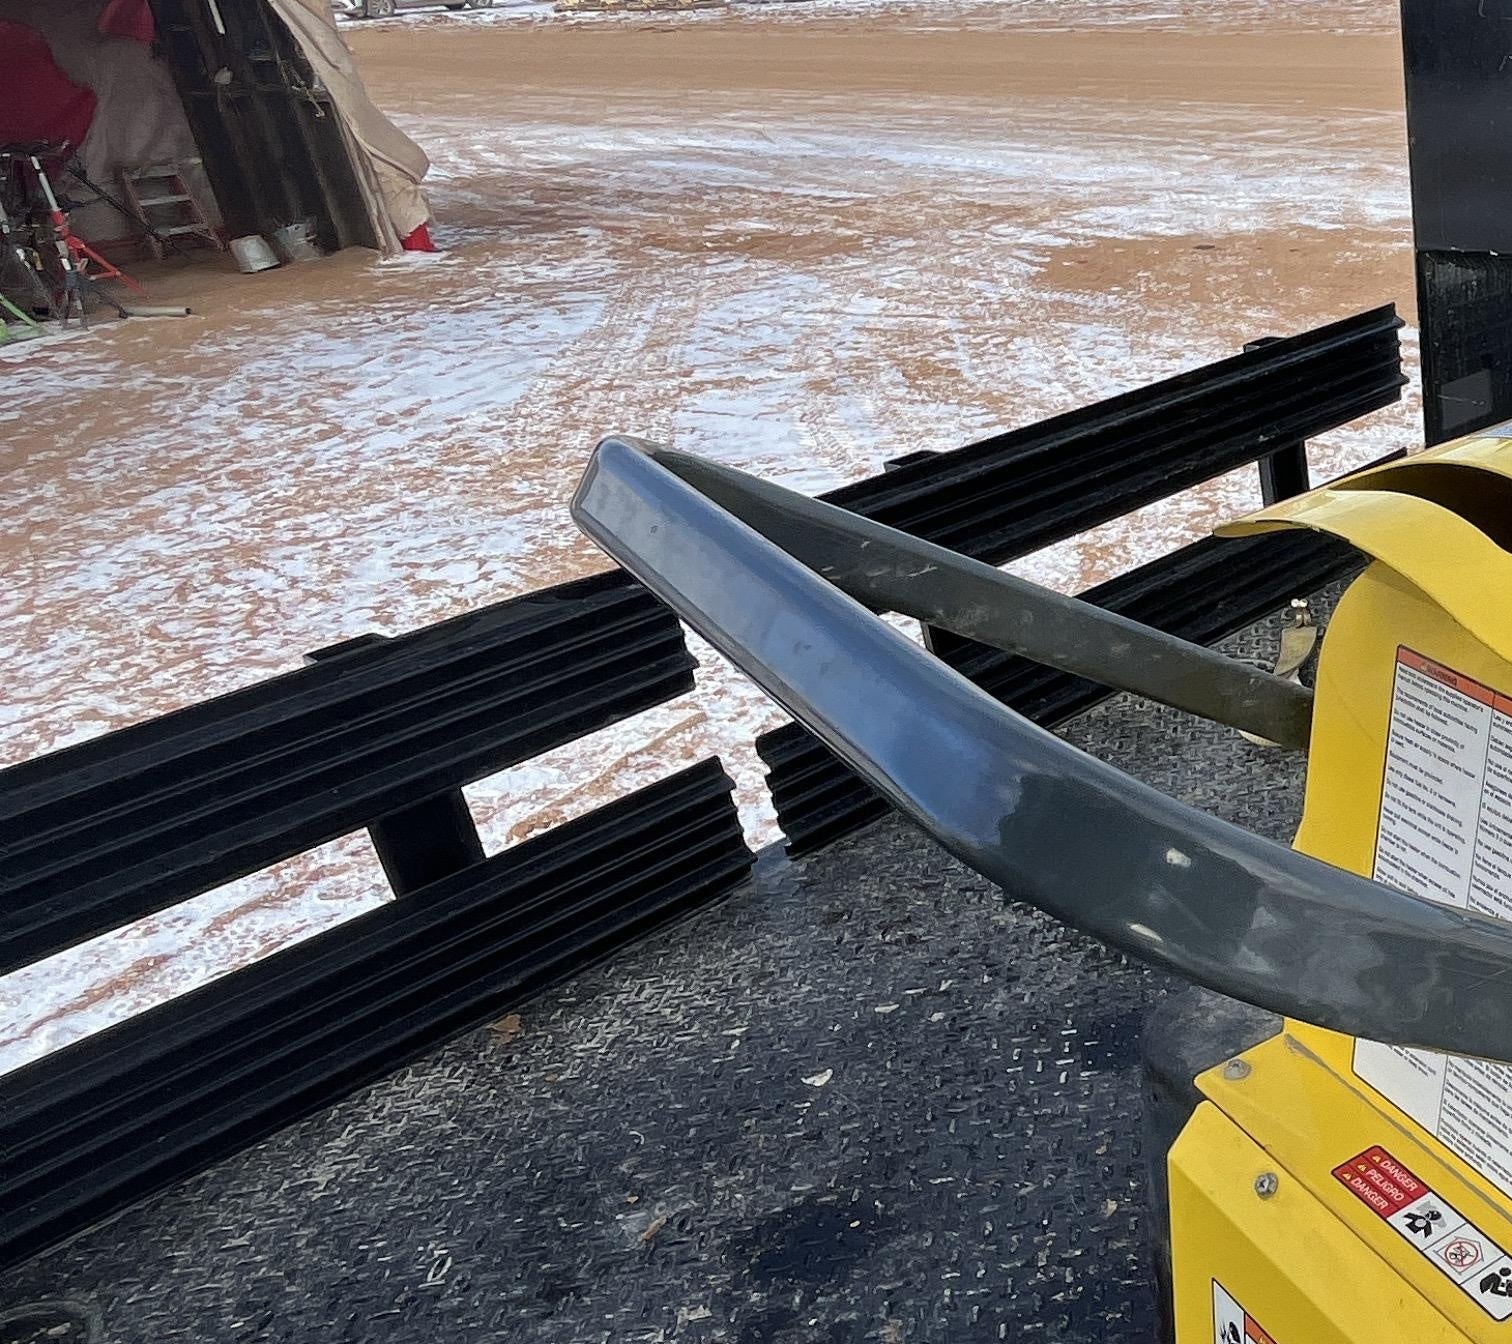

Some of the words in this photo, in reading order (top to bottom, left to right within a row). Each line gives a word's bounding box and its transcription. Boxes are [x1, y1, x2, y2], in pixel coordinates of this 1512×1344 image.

[1364, 1167, 1406, 1202] PELIGRO
[1378, 1159, 1419, 1192] DANGER
[1349, 1176, 1390, 1210] DANGER
